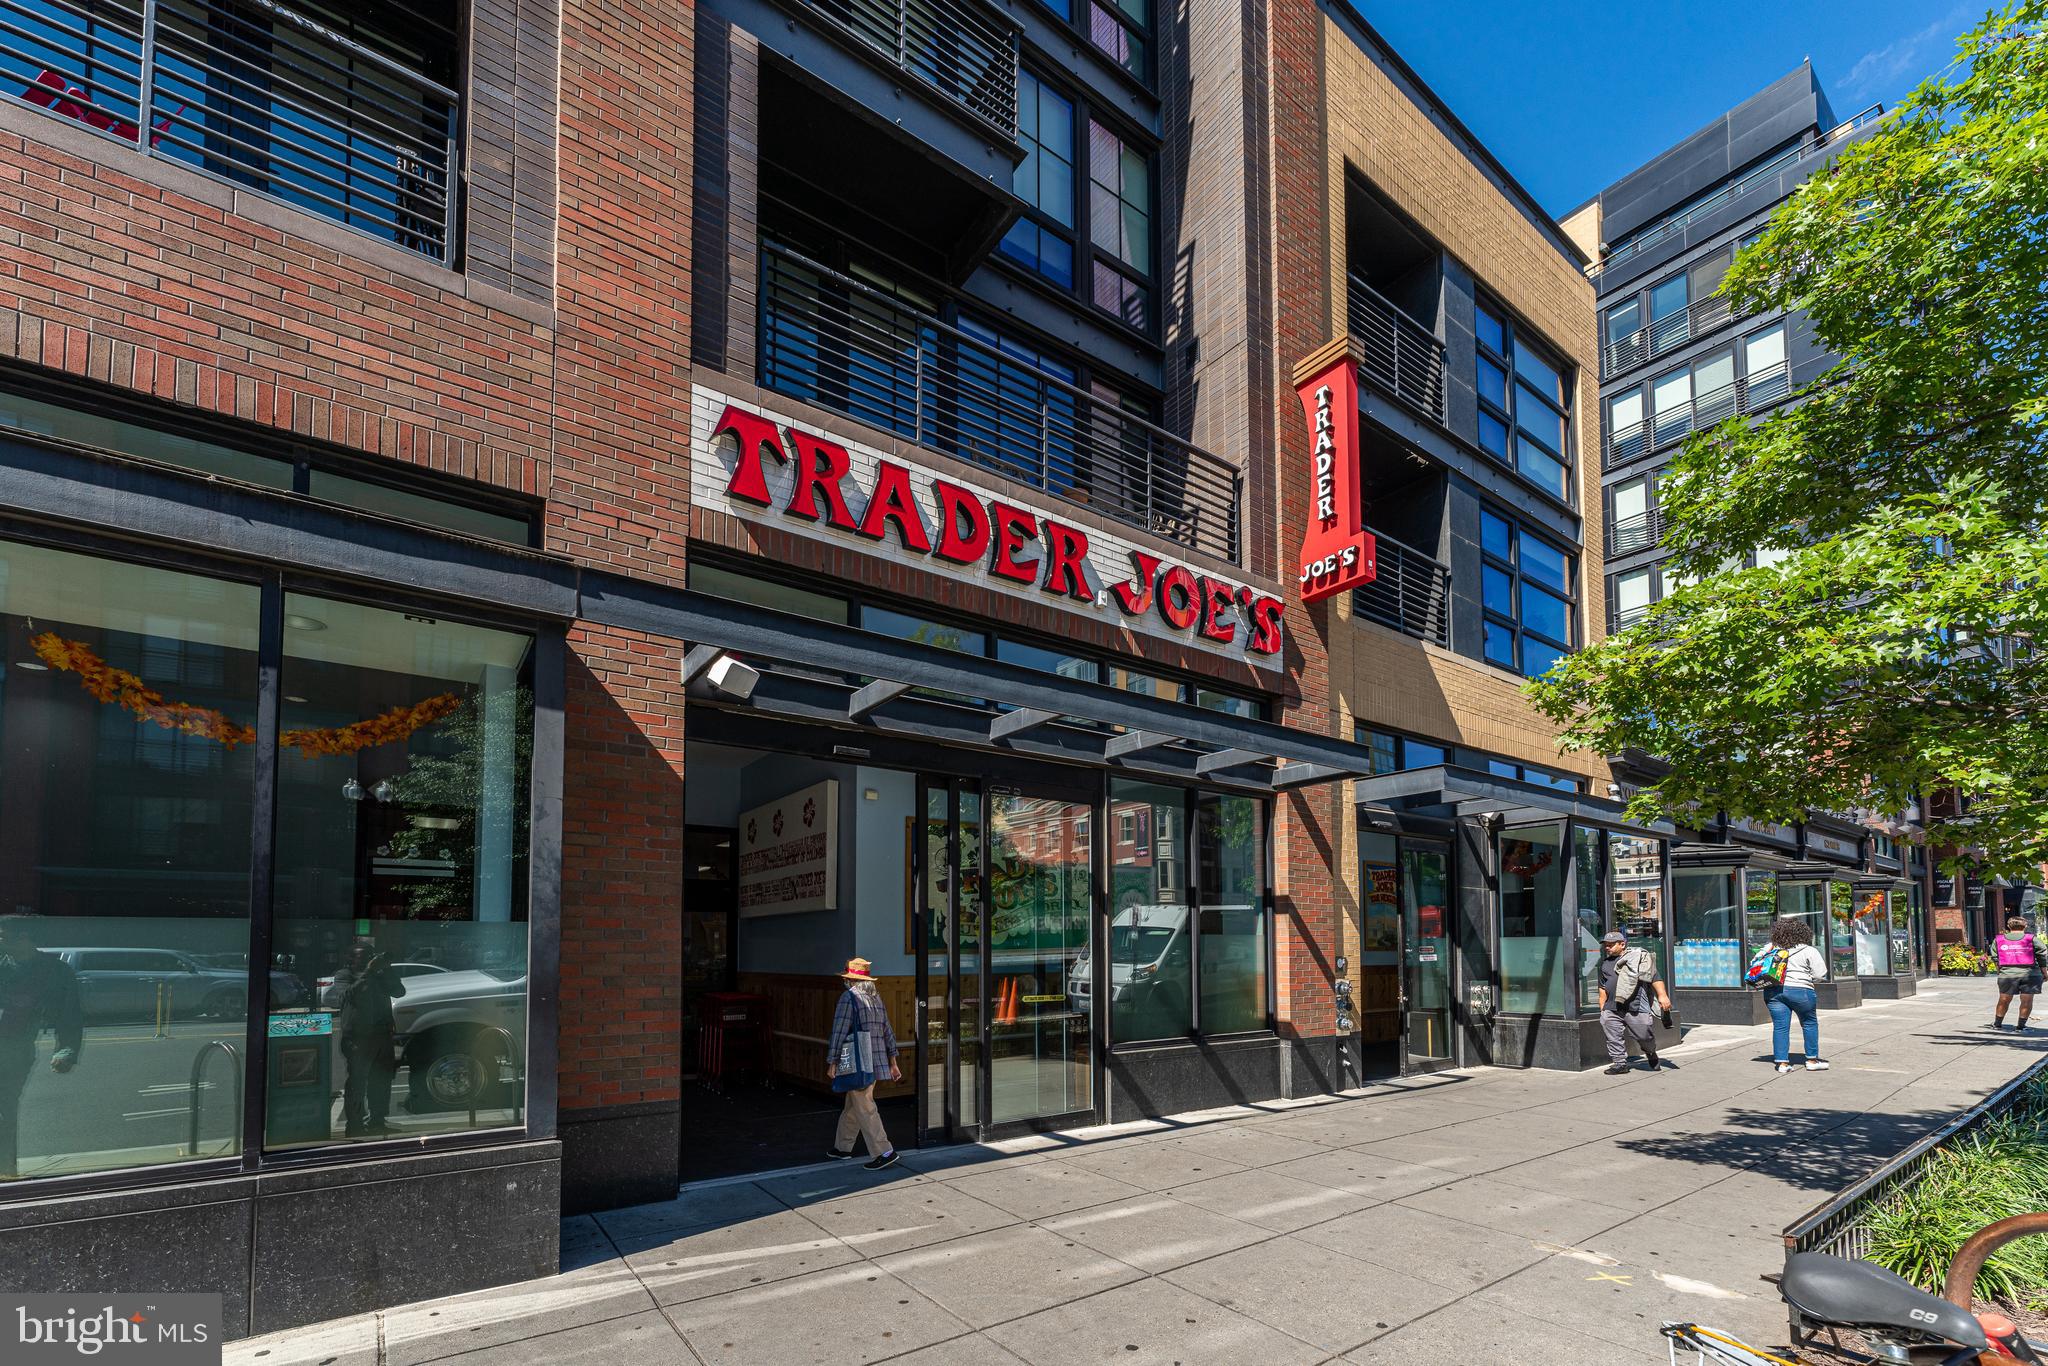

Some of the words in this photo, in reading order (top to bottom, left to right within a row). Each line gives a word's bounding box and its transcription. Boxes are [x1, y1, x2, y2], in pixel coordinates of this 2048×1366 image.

[1313, 384, 1335, 522] TRADER
[709, 404, 1096, 602] TRADER
[1107, 550, 1287, 656] JOE'S
[1299, 545, 1357, 582] JOE'S
